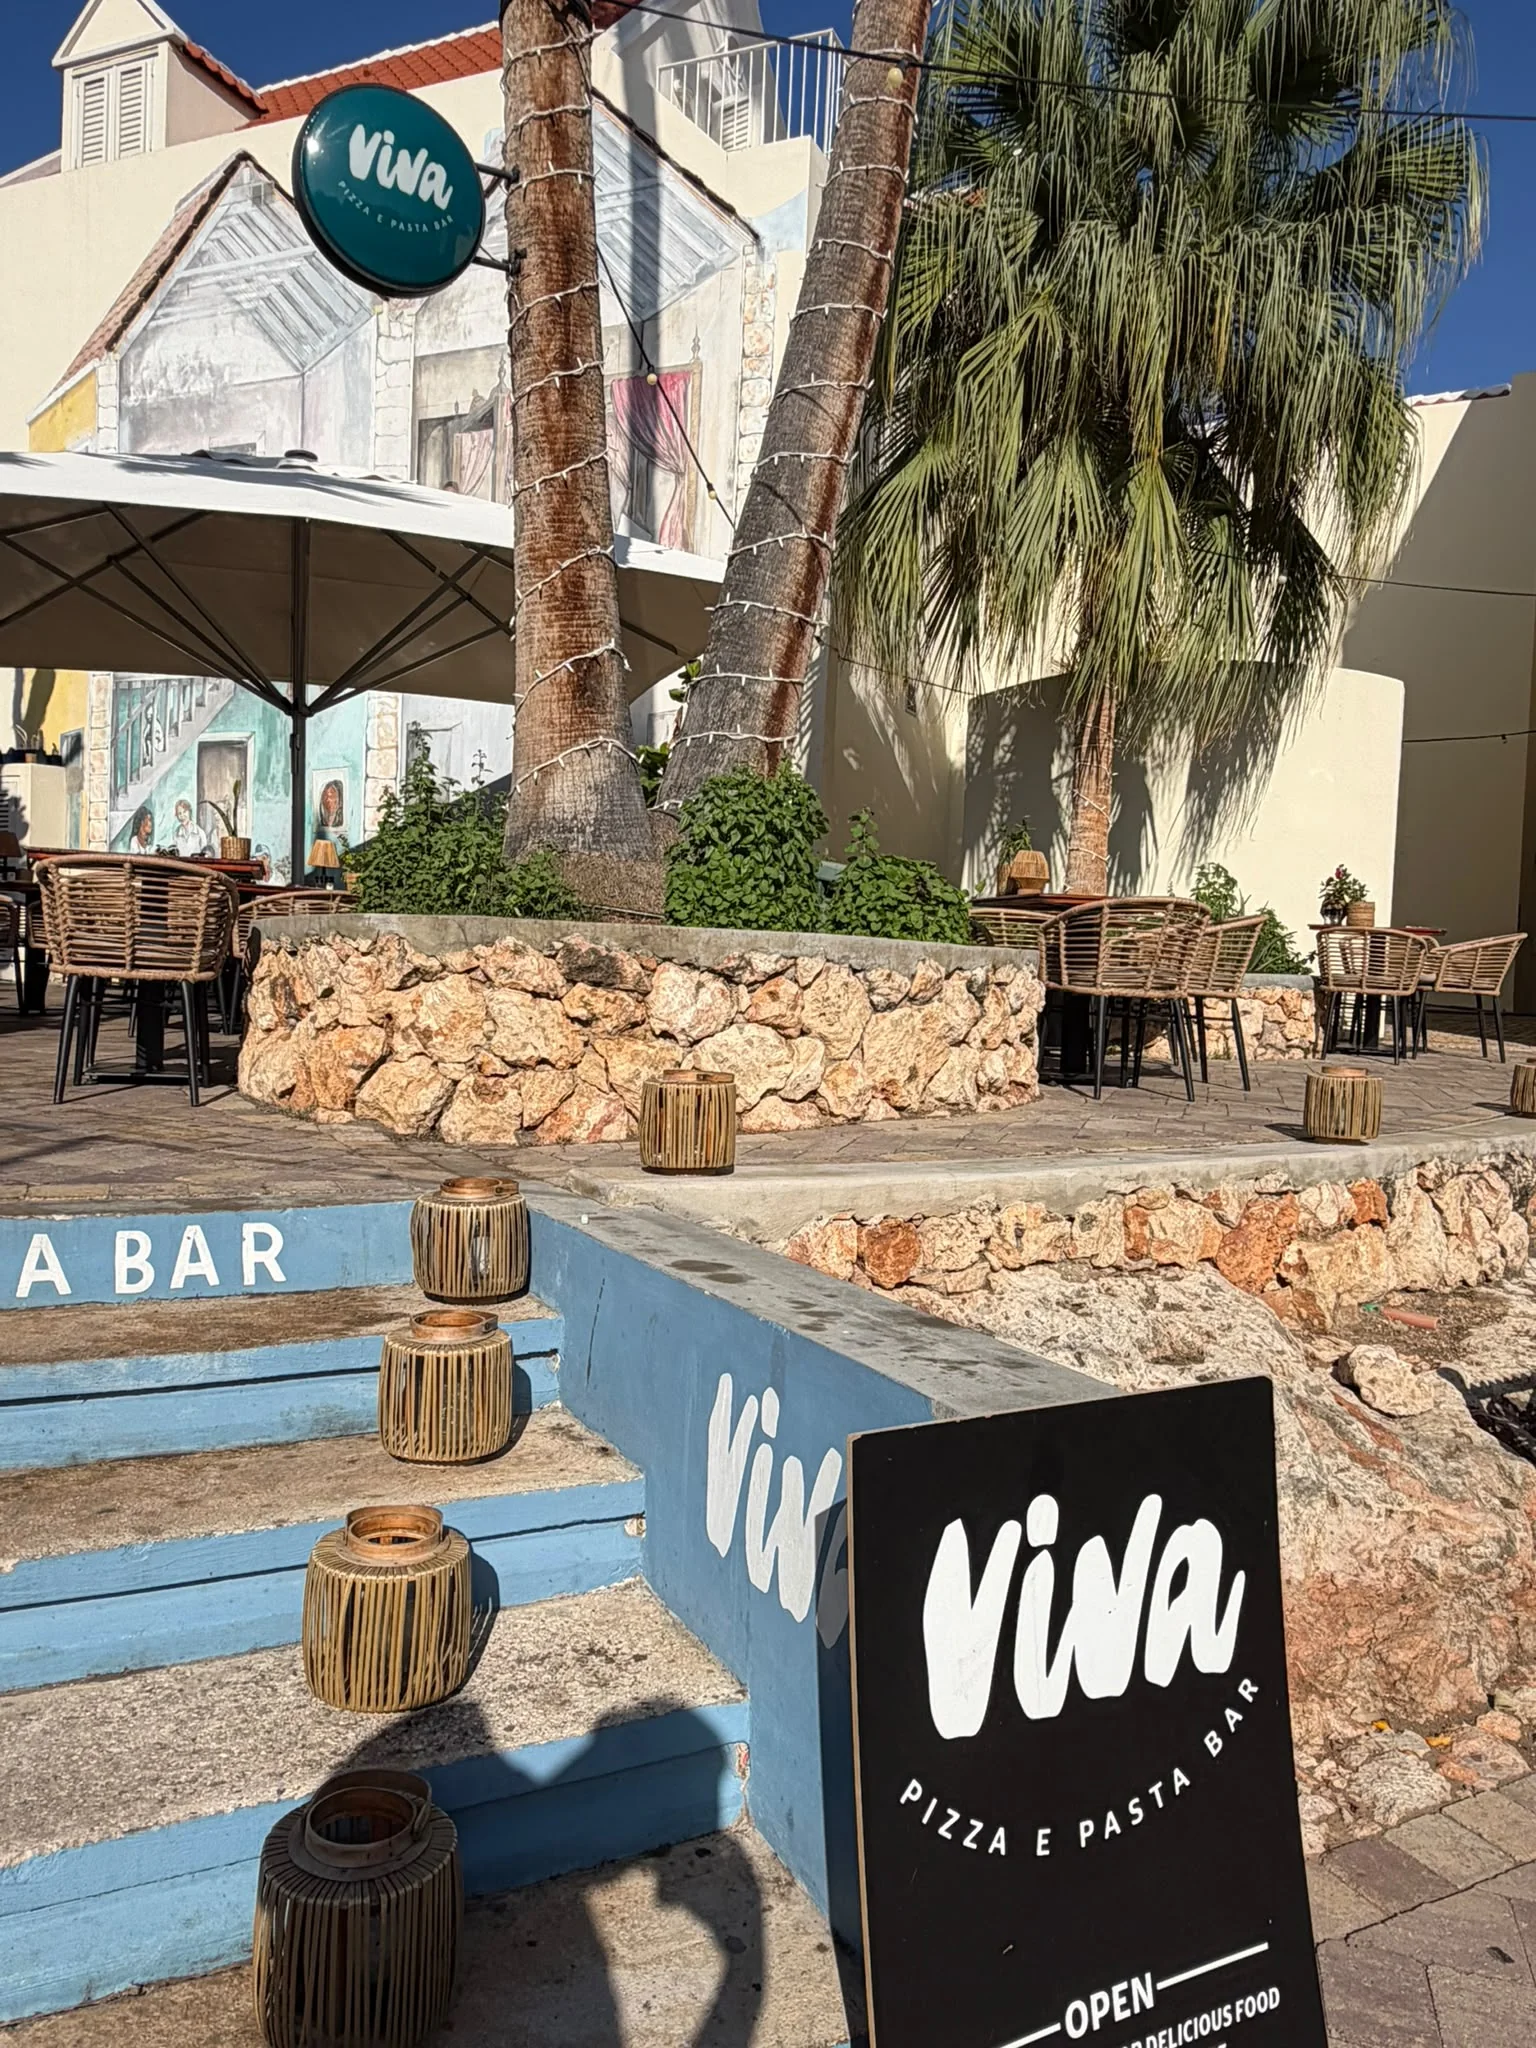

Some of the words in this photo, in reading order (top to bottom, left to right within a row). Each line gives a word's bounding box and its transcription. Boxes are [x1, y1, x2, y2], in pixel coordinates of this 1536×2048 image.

[337, 180, 370, 217] PIZZA
[377, 214, 383, 223] E
[391, 220, 429, 232] PASTA
[434, 215, 454, 231] BAR
[15, 1233, 72, 1298] A
[114, 1222, 287, 1294] BAR
[899, 1778, 1006, 1856] PIZZA
[1036, 1827, 1052, 1857] E
[1079, 1767, 1191, 1848] PASTA
[1203, 1677, 1260, 1758] BAR
[1064, 1971, 1155, 2040] OPEN
[1235, 1986, 1281, 2023] FOOD
